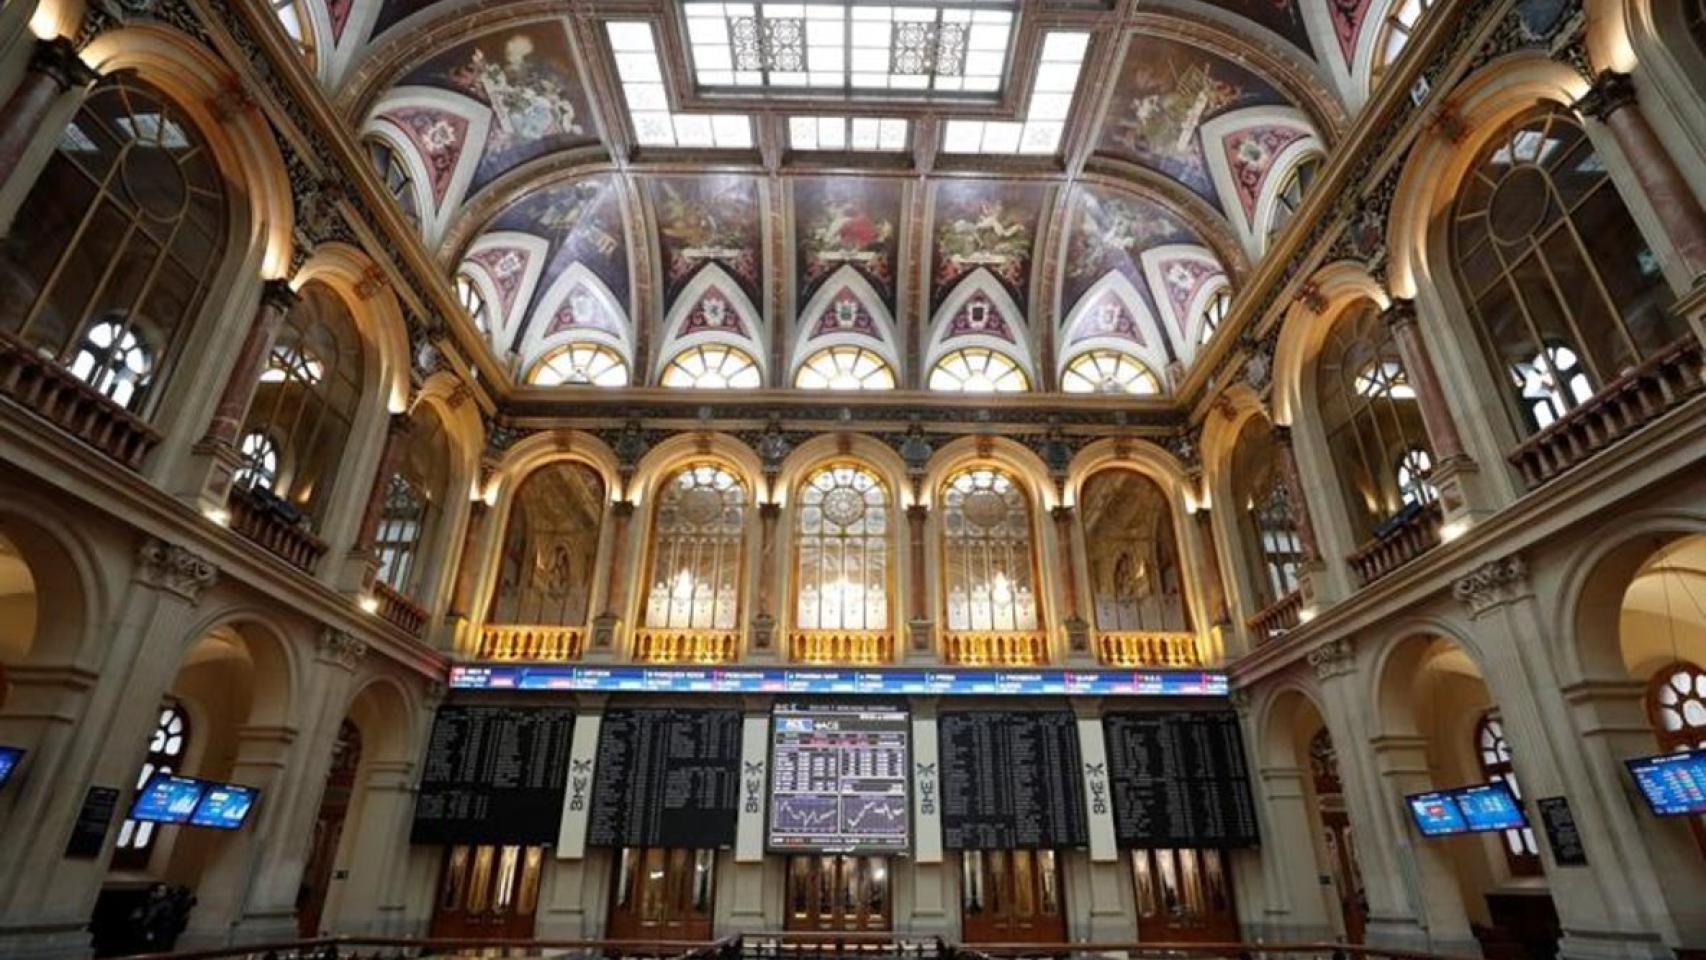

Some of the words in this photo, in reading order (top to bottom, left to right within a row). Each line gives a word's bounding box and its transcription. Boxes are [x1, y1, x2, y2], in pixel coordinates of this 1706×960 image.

[570, 776, 587, 811] BME
[745, 778, 760, 813] BME
[920, 780, 934, 815] BME
[1090, 780, 1106, 814] BME
